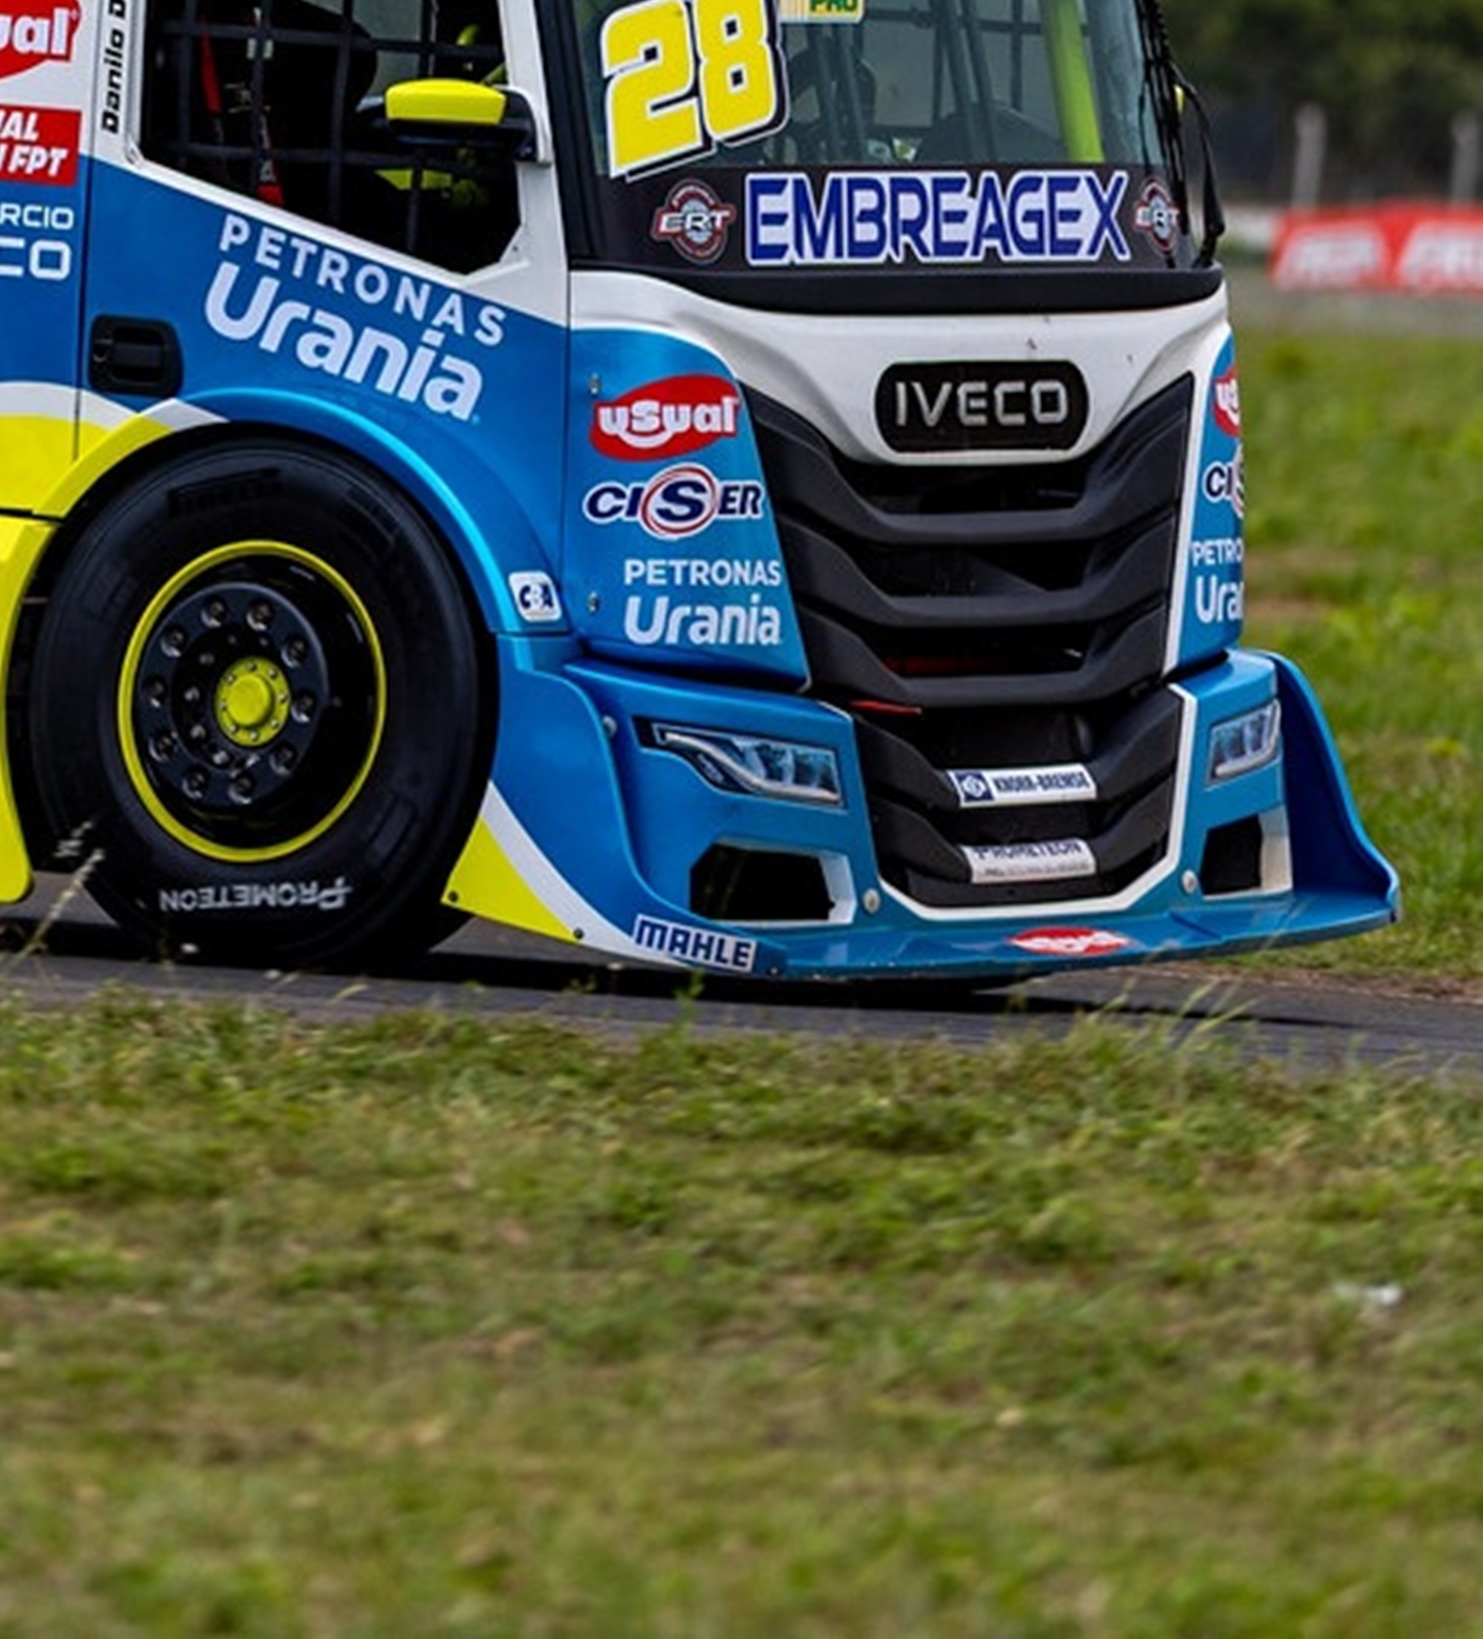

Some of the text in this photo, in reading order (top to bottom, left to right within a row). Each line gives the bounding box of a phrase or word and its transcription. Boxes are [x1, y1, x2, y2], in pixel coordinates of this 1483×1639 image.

[100, 28, 125, 134] Danilo
[7, 146, 68, 177] FPT
[746, 173, 1129, 264] EMBREAGEX
[219, 213, 506, 346] PETRONAS
[205, 261, 483, 422] Urania
[598, 397, 737, 450] usual
[895, 380, 1067, 428] IVECO
[585, 479, 764, 523] CISER
[624, 559, 782, 586] PETRONAS
[1192, 537, 1244, 567] PETRO
[624, 592, 782, 646] Urania
[1195, 574, 1244, 624] Ura
[159, 876, 353, 912] PROMETEON
[635, 919, 752, 968] MAHLE
